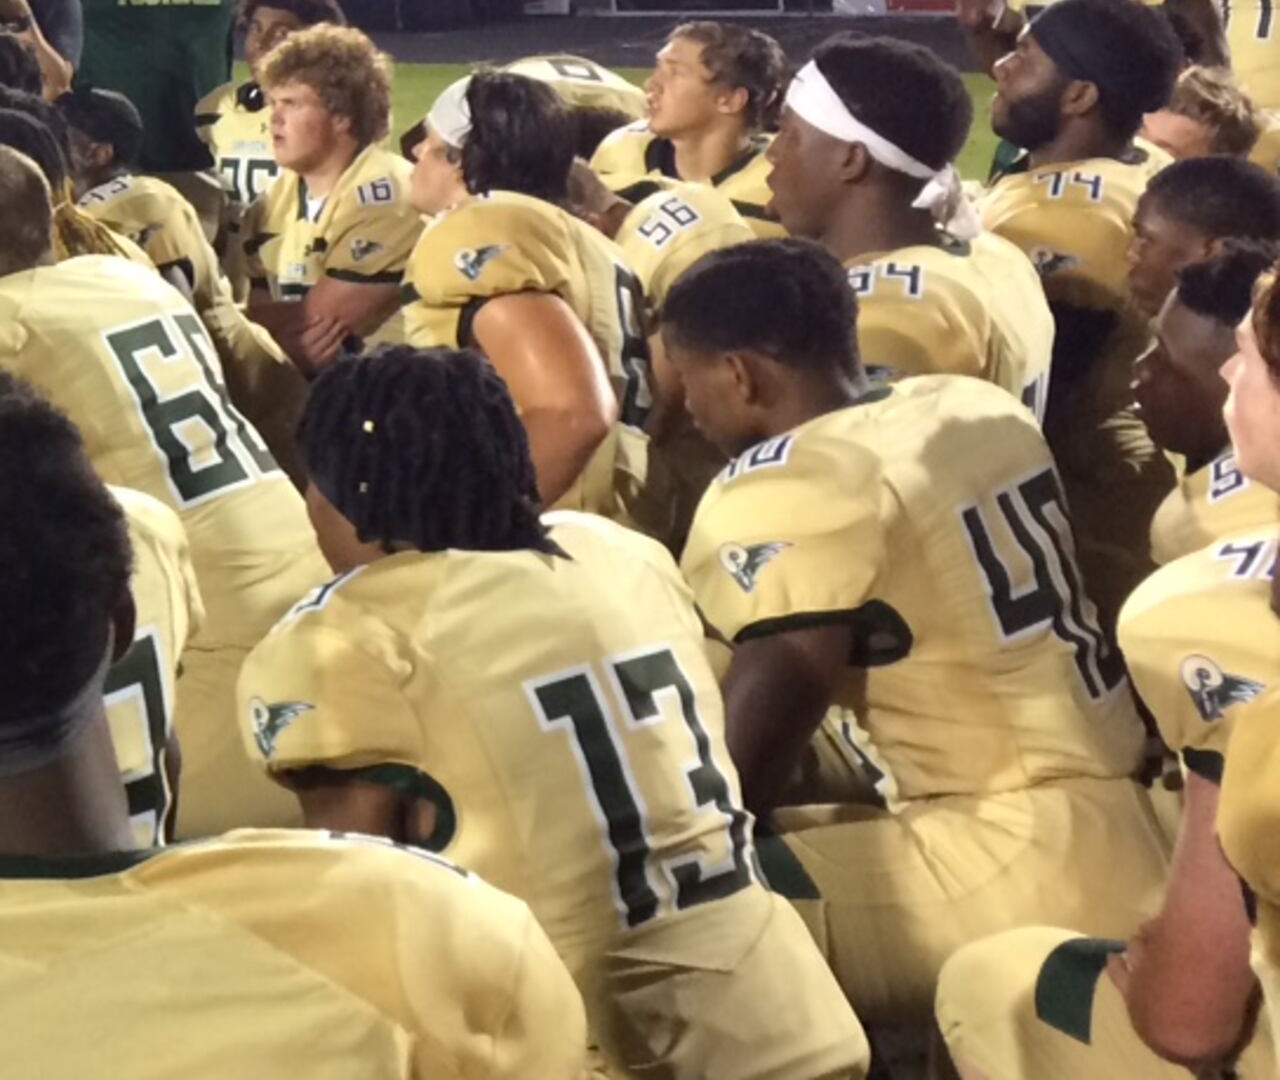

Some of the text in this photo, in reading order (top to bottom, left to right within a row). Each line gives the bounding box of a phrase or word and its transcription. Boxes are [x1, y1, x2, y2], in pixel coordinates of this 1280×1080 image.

[1035, 170, 1105, 201] 74
[637, 196, 701, 248] 56
[525, 644, 756, 932] 13
